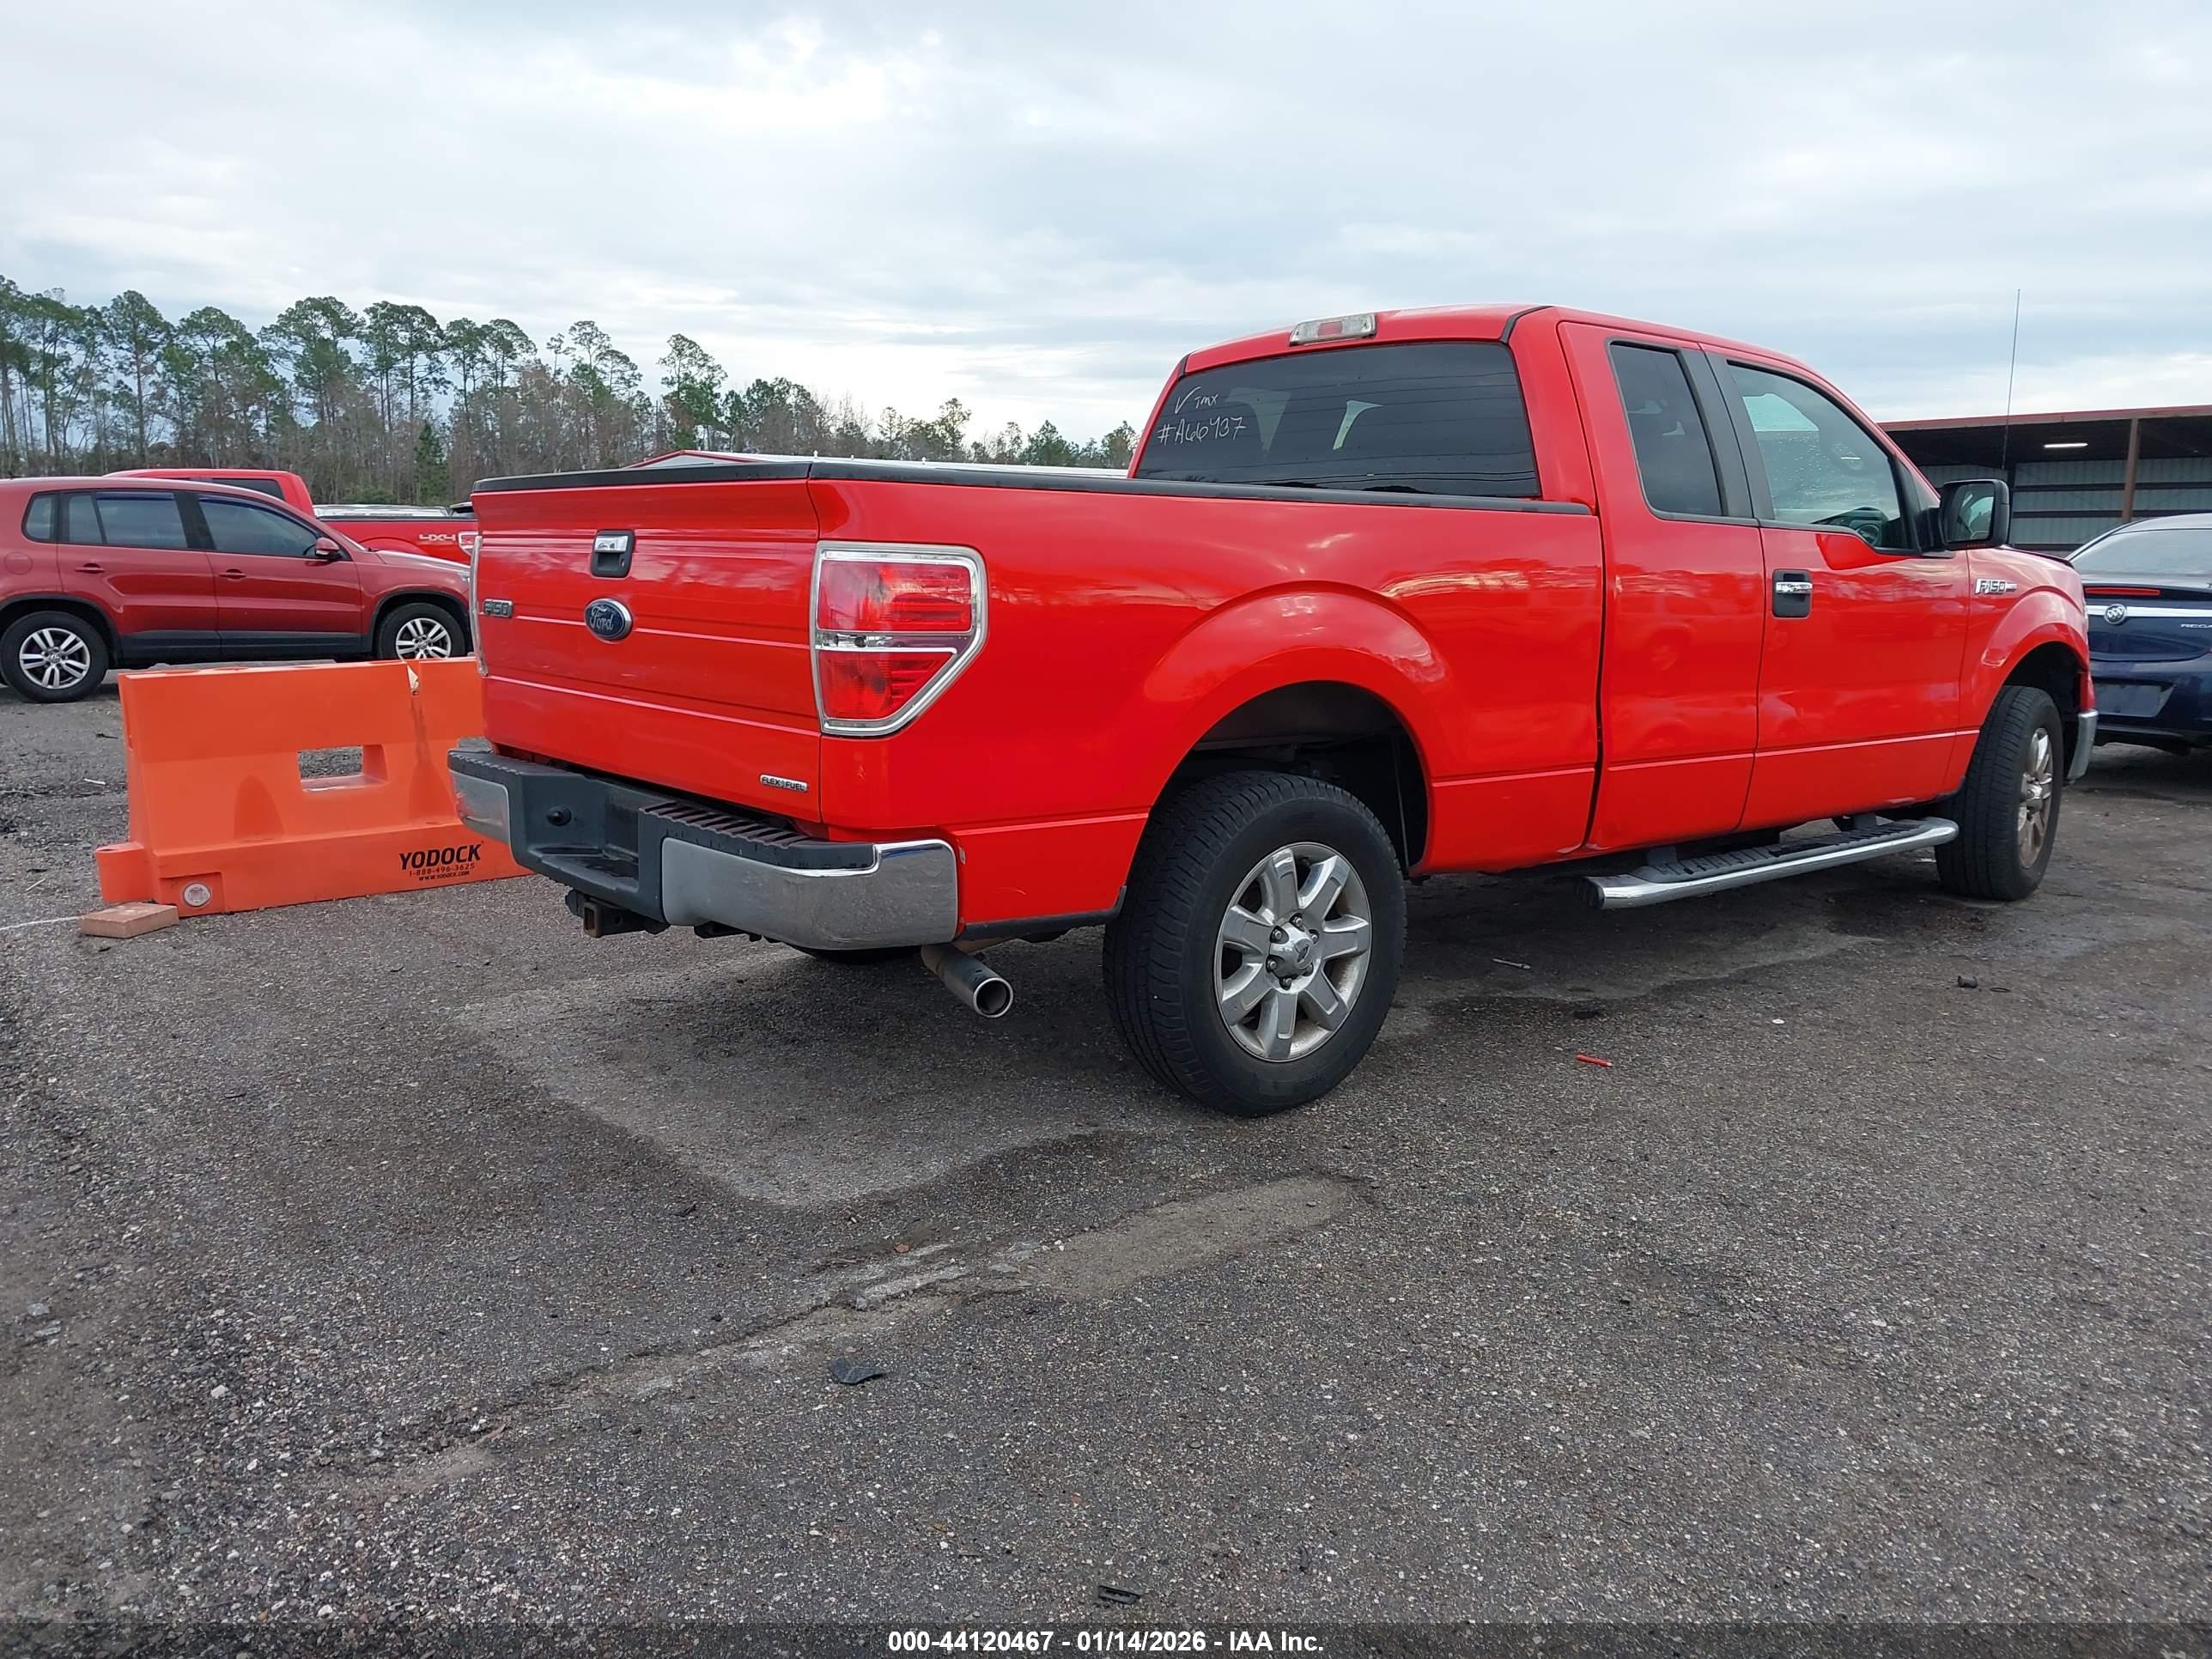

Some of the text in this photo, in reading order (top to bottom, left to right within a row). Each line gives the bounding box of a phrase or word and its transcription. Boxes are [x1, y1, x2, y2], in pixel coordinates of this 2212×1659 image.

[590, 605, 614, 630] Ford
[762, 776, 805, 791] FLEX FUEL
[399, 843, 482, 871] YODOCK
[409, 862, 475, 878] 1-888-496-3625
